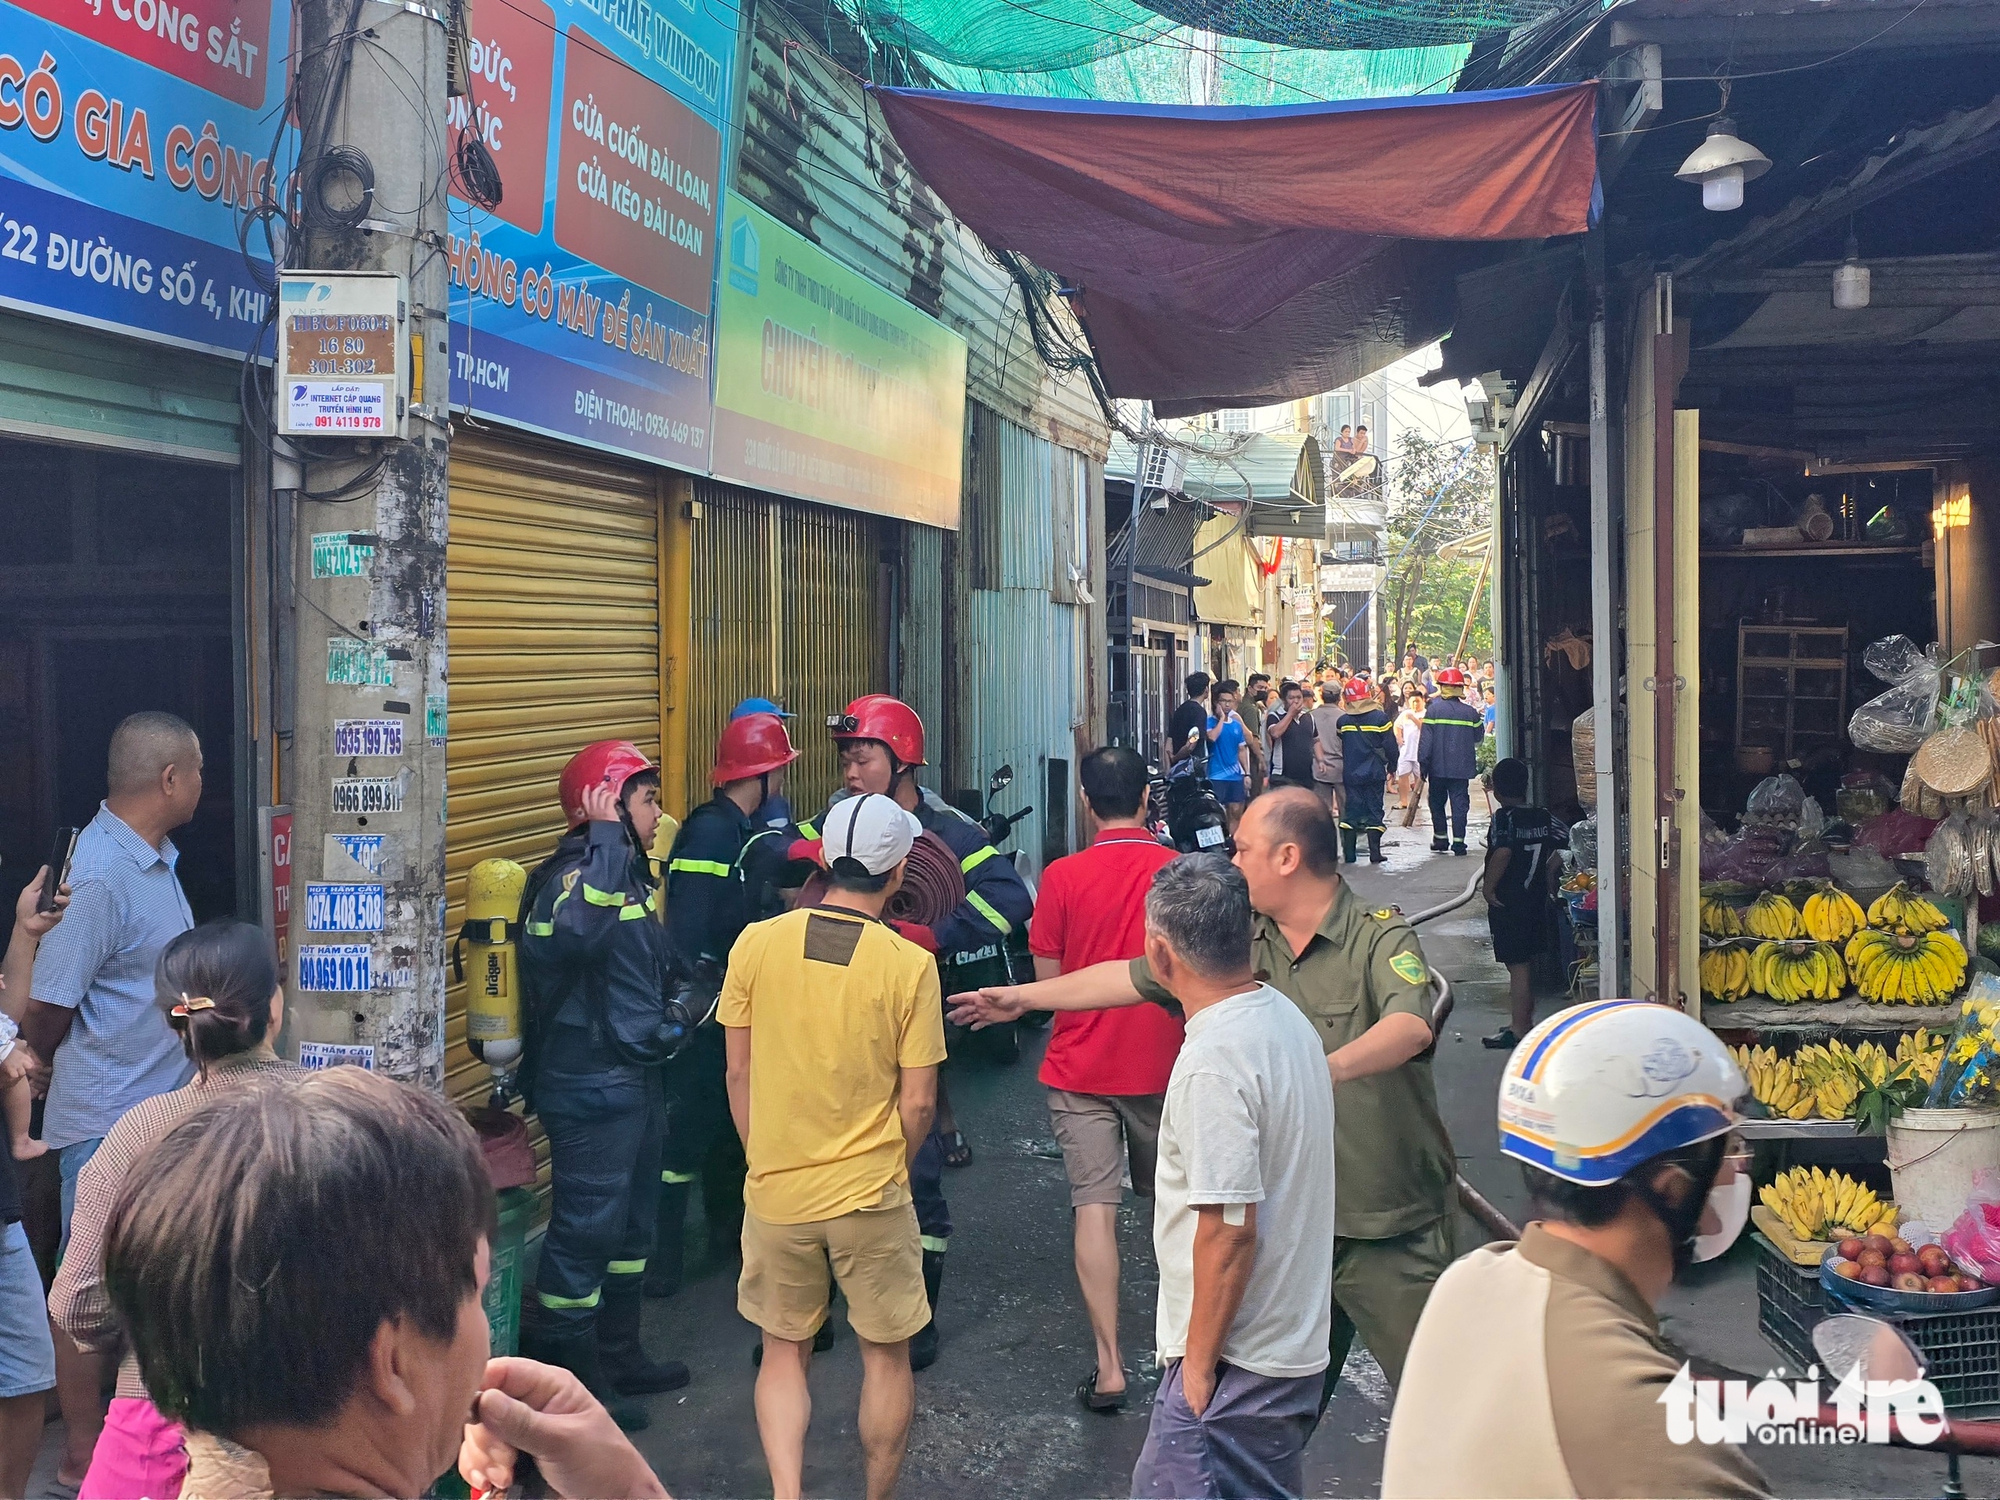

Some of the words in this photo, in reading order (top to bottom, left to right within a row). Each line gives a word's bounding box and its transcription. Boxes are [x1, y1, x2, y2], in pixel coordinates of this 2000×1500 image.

[205, 16, 258, 79] SẮT
[470, 37, 516, 102] ĐỨC,
[654, 12, 721, 105] WINDOW
[74, 89, 155, 180] GIA
[164, 120, 278, 216] CÔNG
[572, 93, 604, 146] CỬA
[607, 124, 649, 172] CUỐN
[650, 147, 674, 188] ĐÀI
[676, 164, 712, 216] LOAN,
[577, 155, 608, 206] CỬA
[611, 178, 641, 222] KÉO
[643, 197, 667, 237] ĐÀI
[669, 213, 703, 257] LOAN
[47, 231, 153, 294] ĐƯỜNG
[159, 260, 197, 306] SỐ
[201, 279, 222, 320] 4,
[319, 337, 339, 354] 16
[343, 337, 365, 354] 80
[521, 261, 554, 321] CÓ
[556, 279, 601, 338] MÁY
[602, 288, 631, 351] ĐỂ
[630, 302, 667, 364] SẢN
[666, 323, 709, 380] XUẤT
[308, 359, 375, 374] 301-302
[456, 351, 509, 392] TP.HCM
[310, 394, 342, 403] INTERNET
[358, 395, 381, 404] QUANG
[314, 415, 333, 428] 091
[335, 416, 360, 428] 4119
[362, 416, 382, 429] 978
[574, 389, 603, 425] ĐIỆN
[606, 400, 642, 436] THOẠI:
[645, 412, 669, 440] 0936
[671, 416, 689, 445] 469
[691, 424, 705, 449] 137
[335, 727, 402, 755] 0935.199.795
[1523, 843, 1542, 889] 7
[307, 894, 382, 930] 0974.408.508
[485, 953, 500, 995] Dräger
